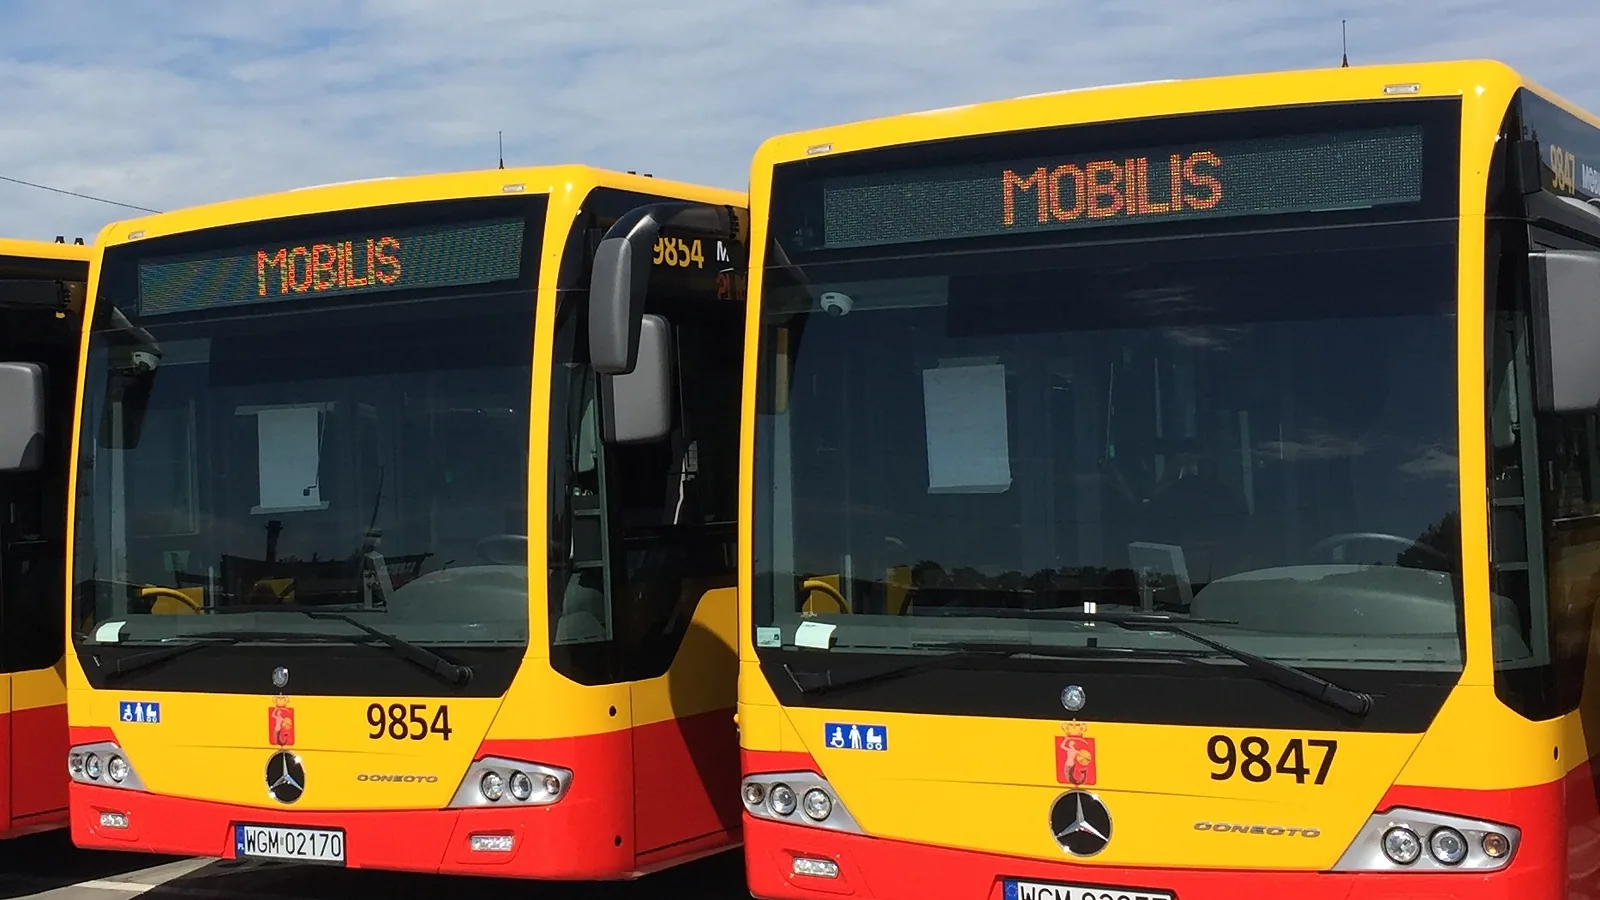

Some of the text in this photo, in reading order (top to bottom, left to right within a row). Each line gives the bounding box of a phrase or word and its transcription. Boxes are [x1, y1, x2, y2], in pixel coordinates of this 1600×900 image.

[1002, 150, 1222, 226] MOBILIS
[1550, 144, 1576, 196] 9847
[257, 236, 402, 296] MOBILIS
[653, 236, 704, 269] 9854
[366, 703, 453, 741] 9854
[1207, 734, 1338, 785] 9847
[246, 829, 341, 857] WGM 02170
